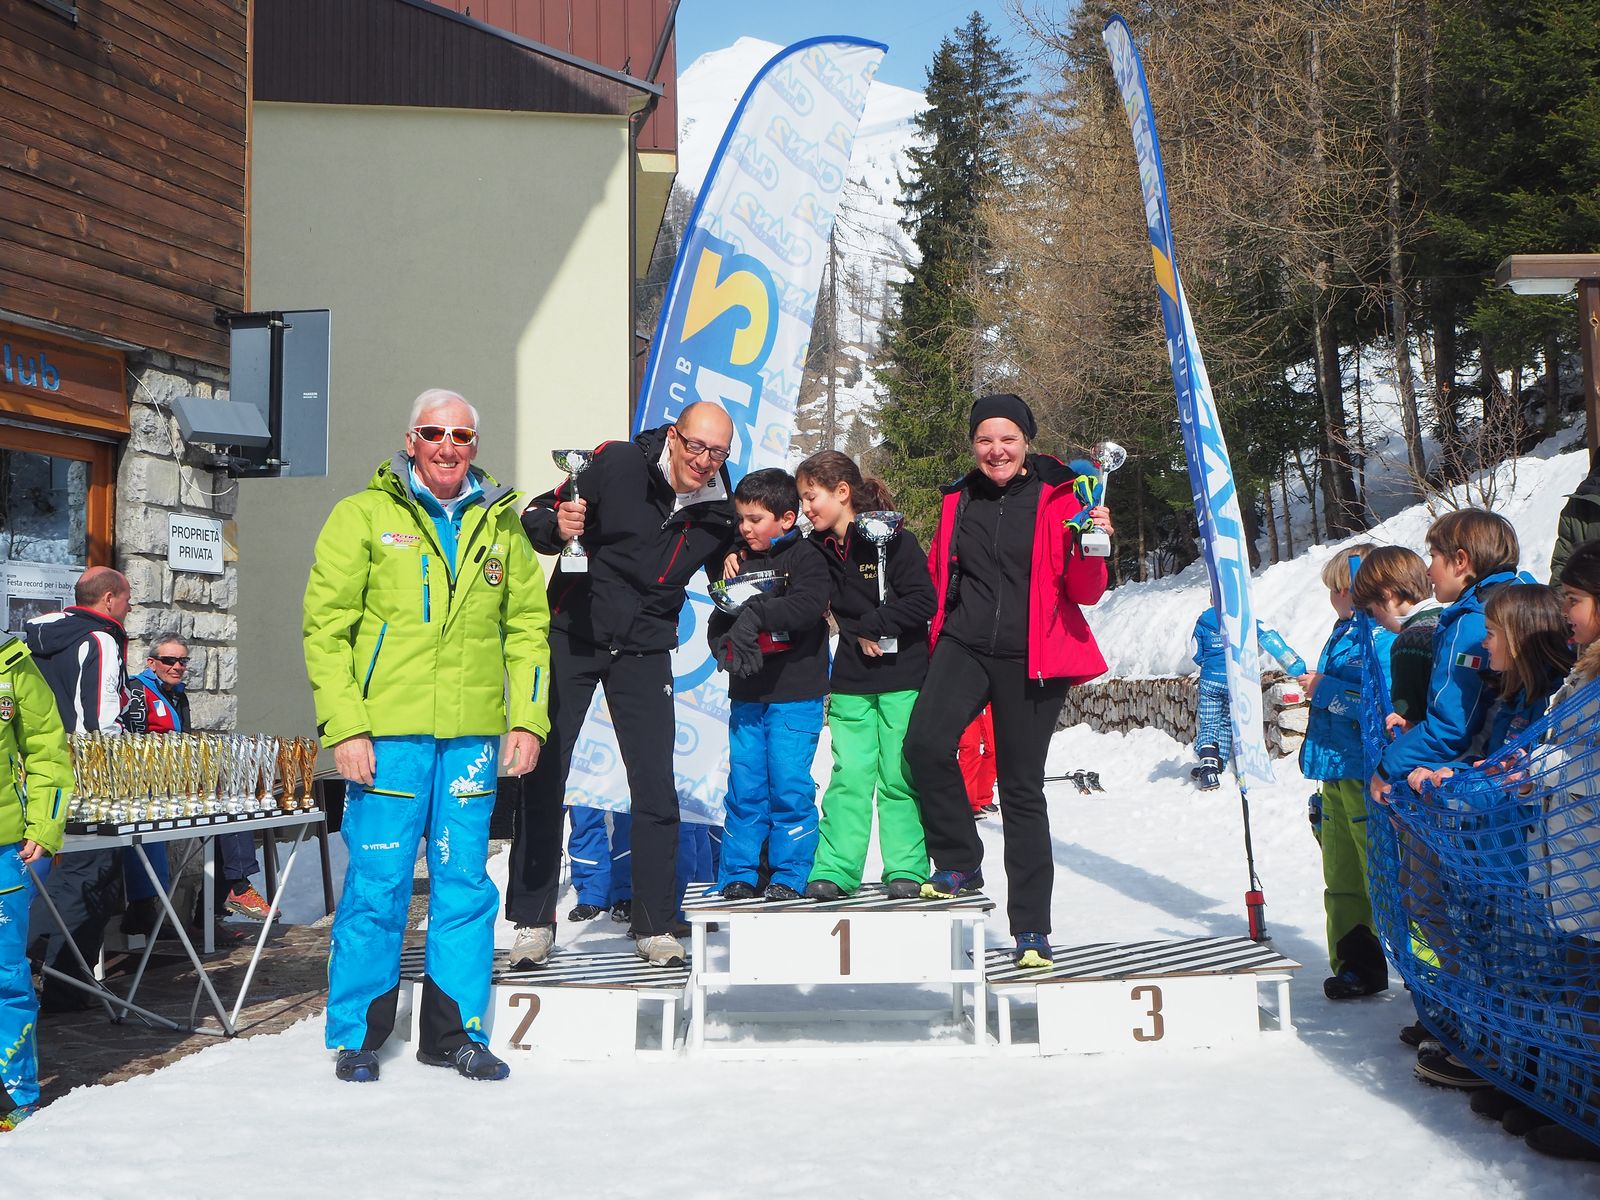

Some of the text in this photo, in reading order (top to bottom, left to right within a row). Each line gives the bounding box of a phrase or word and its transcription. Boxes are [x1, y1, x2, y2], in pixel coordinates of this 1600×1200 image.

[3, 343, 60, 391] lub
[171, 525, 220, 543] PROPRIETÀ
[179, 545, 214, 561] PRIVATA
[7, 578, 23, 587] Festa
[24, 580, 43, 588] record
[58, 582, 72, 592] baby
[831, 919, 851, 975] 1
[508, 993, 541, 1050] 2
[1131, 985, 1164, 1042] 3
